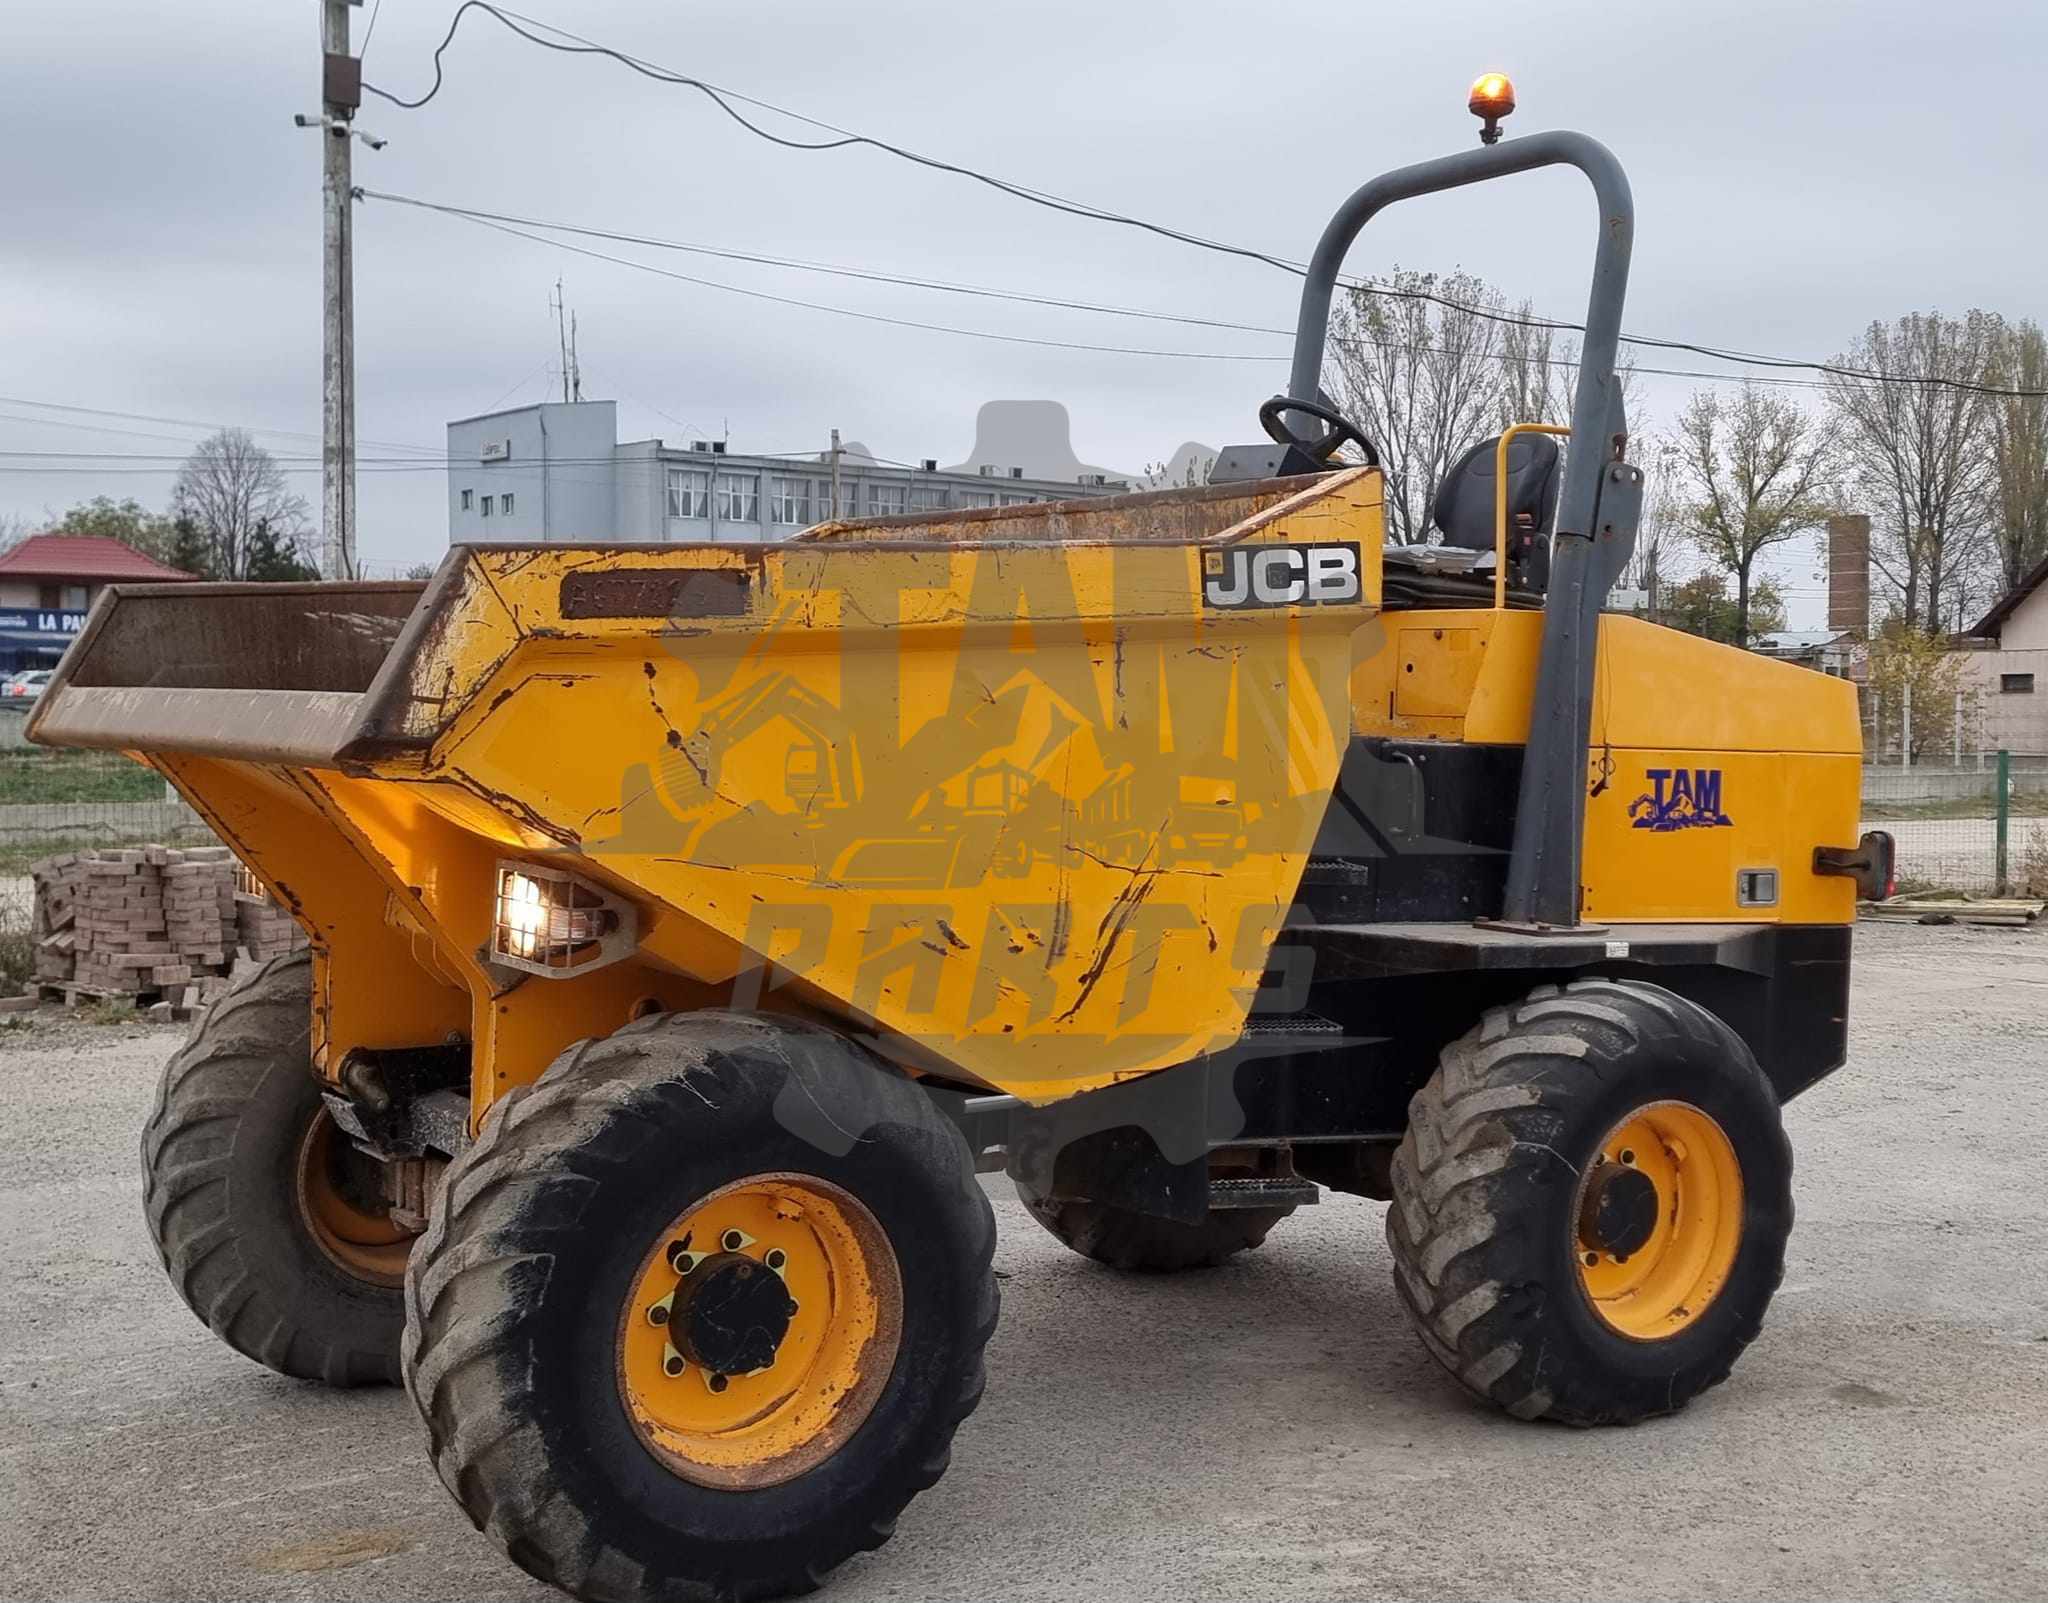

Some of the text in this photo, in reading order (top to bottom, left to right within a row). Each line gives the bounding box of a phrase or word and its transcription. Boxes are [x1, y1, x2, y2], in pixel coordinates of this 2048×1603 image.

[1206, 548, 1358, 605] JCB
[38, 613, 57, 631] LA
[1646, 768, 1722, 820] TAM
